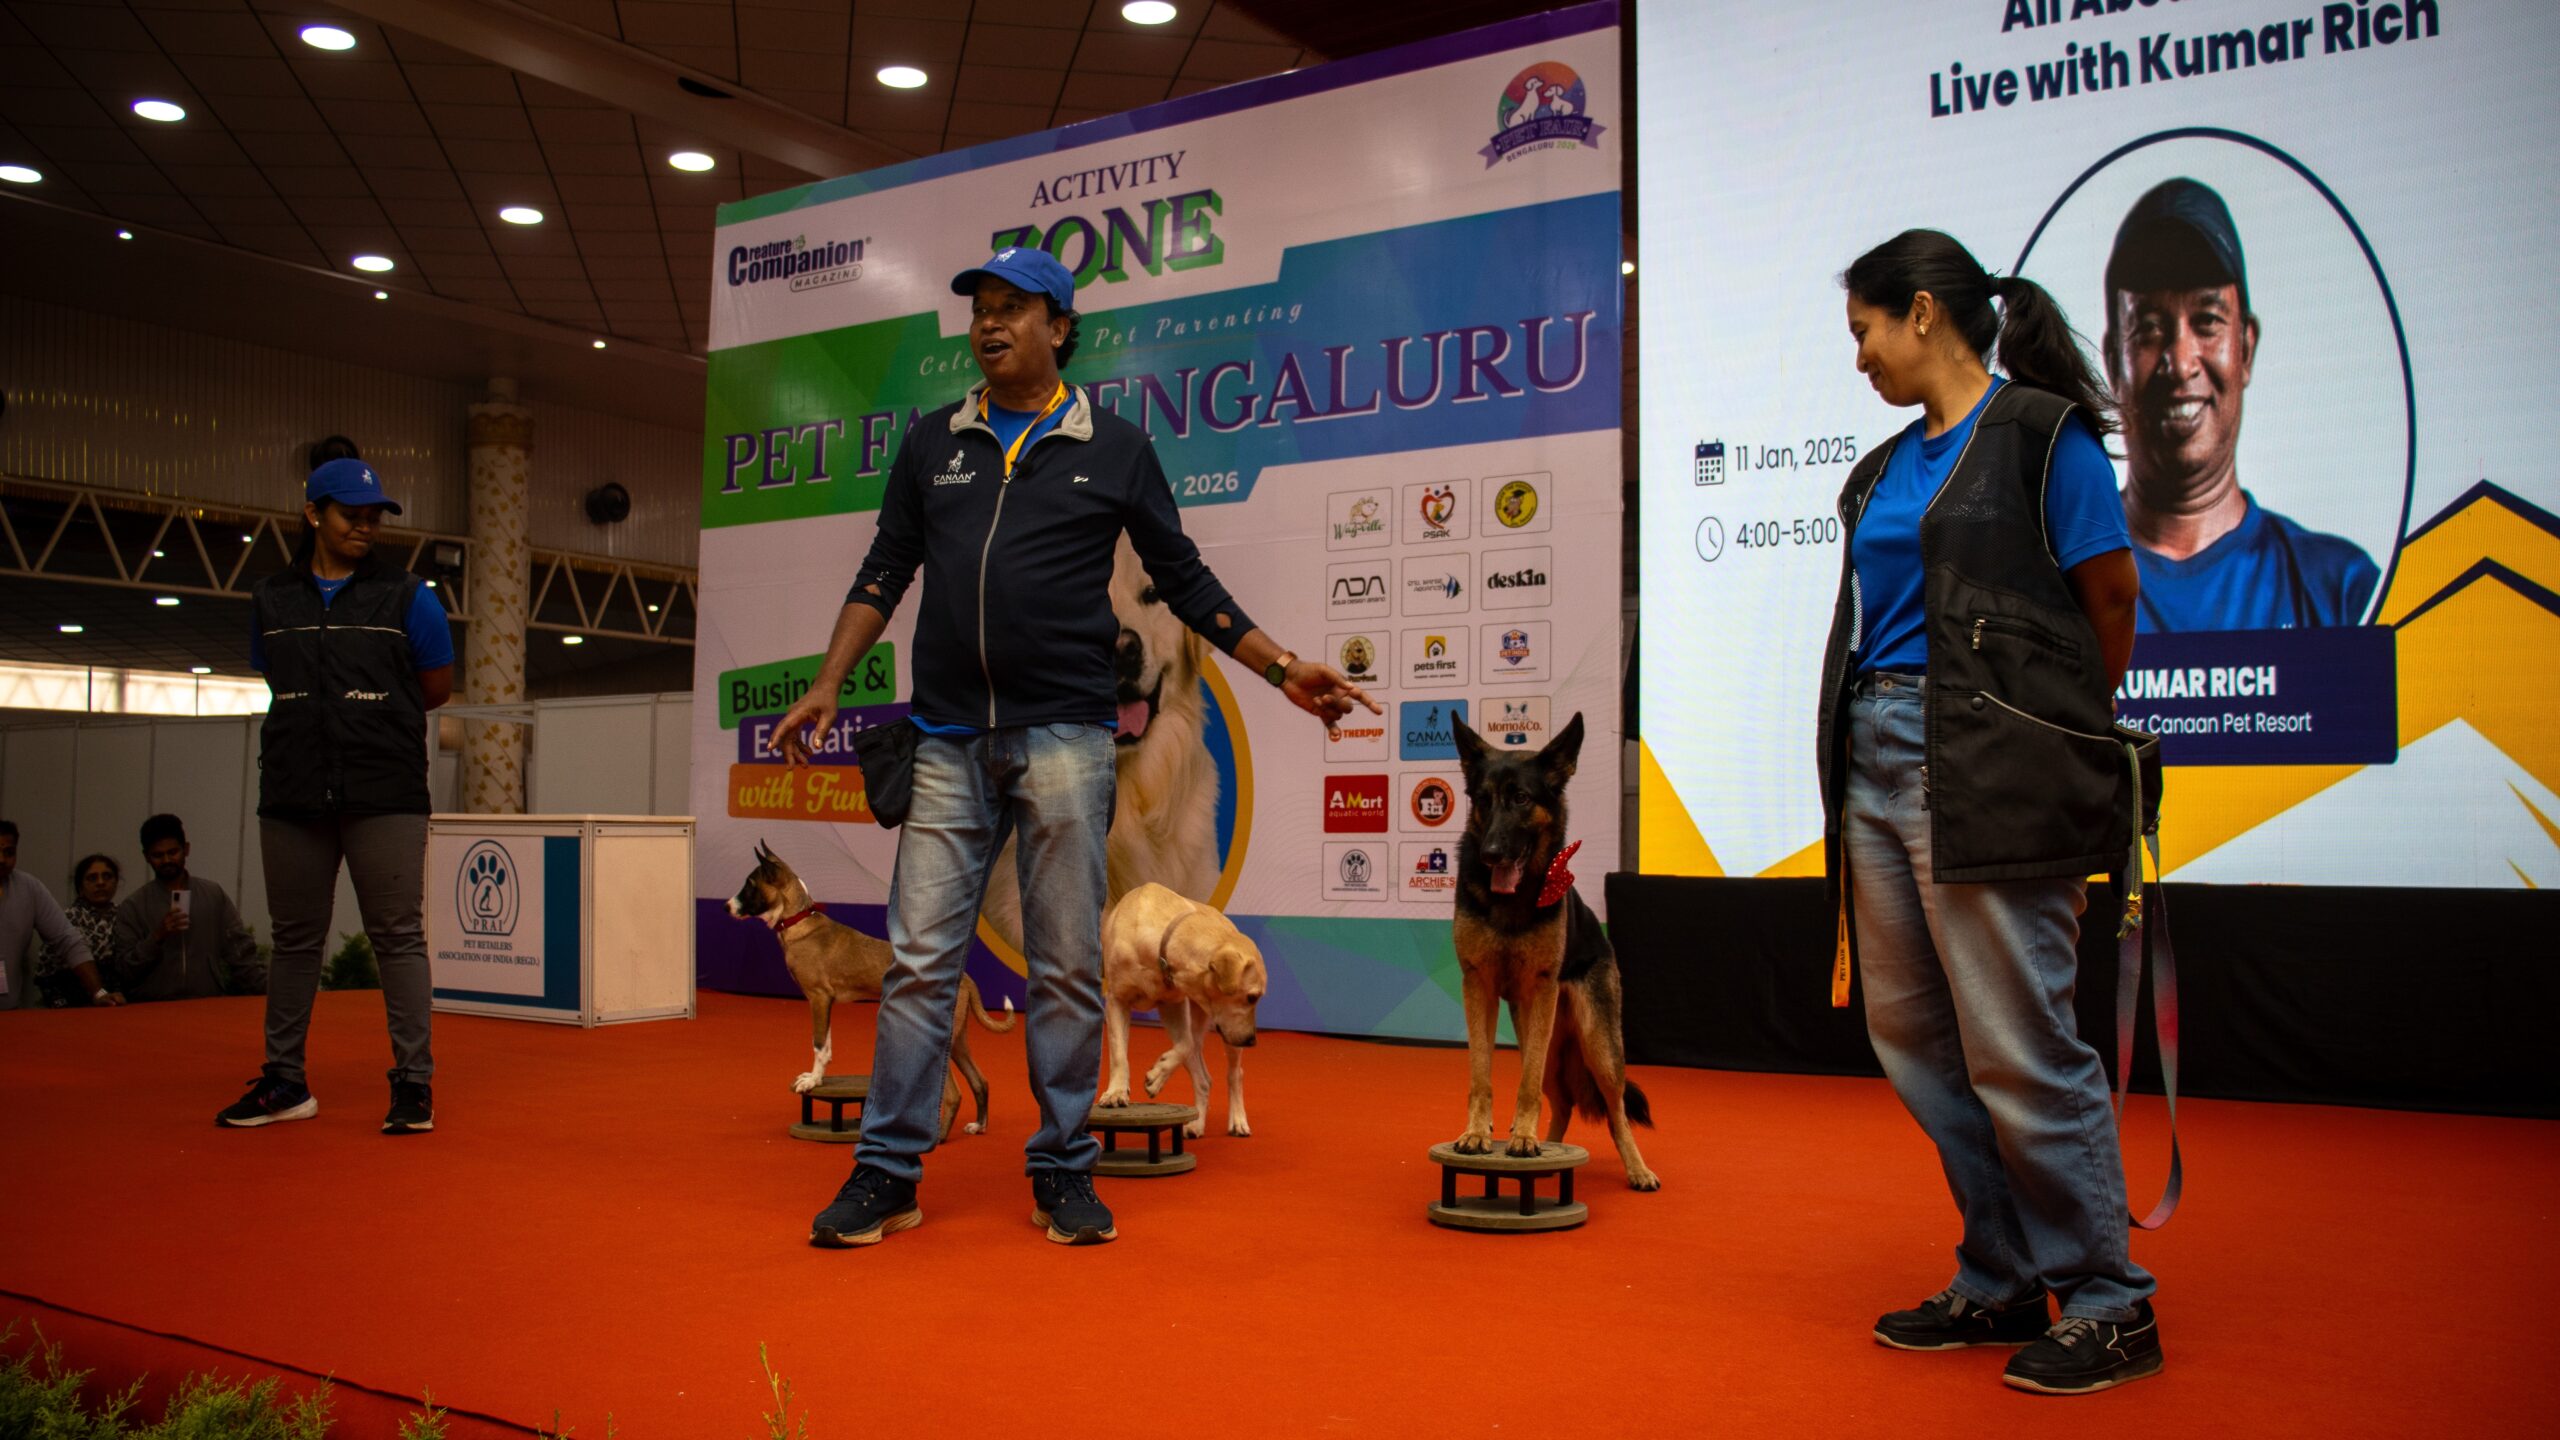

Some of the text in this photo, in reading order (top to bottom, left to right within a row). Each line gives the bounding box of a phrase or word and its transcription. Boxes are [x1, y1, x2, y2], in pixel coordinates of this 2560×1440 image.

[2001, 0, 2062, 33] All
[1929, 0, 2439, 118] Live with Kumar Rich
[1499, 119, 1582, 150] PET FAIR
[1506, 141, 1576, 162] BENGALURU 2026
[1029, 150, 1187, 208] ACTIVITY
[794, 267, 858, 288] MAGAZINE
[1095, 303, 1303, 348] Pet Parenting
[720, 419, 845, 494] PET
[1084, 309, 1596, 441] ENGALURU
[1735, 436, 1857, 472] 11 Jan, 2025
[933, 473, 972, 484] CANAAN
[1183, 471, 1239, 497] 2026
[1422, 529, 1451, 540] PSAK
[1735, 517, 1838, 549] 4:00-5:00
[1414, 659, 1456, 673] pets first
[731, 656, 889, 714] Busins &
[2209, 666, 2276, 697] RICH
[1488, 720, 1542, 733] Momo&Co.
[2147, 713, 2218, 735] Canaan
[2223, 713, 2251, 733] Pet
[2256, 711, 2312, 732] Resort
[1407, 730, 1452, 743] CANAA
[738, 770, 868, 813] with Fun
[1328, 809, 1384, 818] aquatic world
[473, 918, 504, 932] PRAI
[437, 951, 481, 962] ASSOCIATION
[482, 954, 492, 963] OF
[493, 955, 513, 964] INDIA
[464, 939, 513, 951] PET RETAILERS
